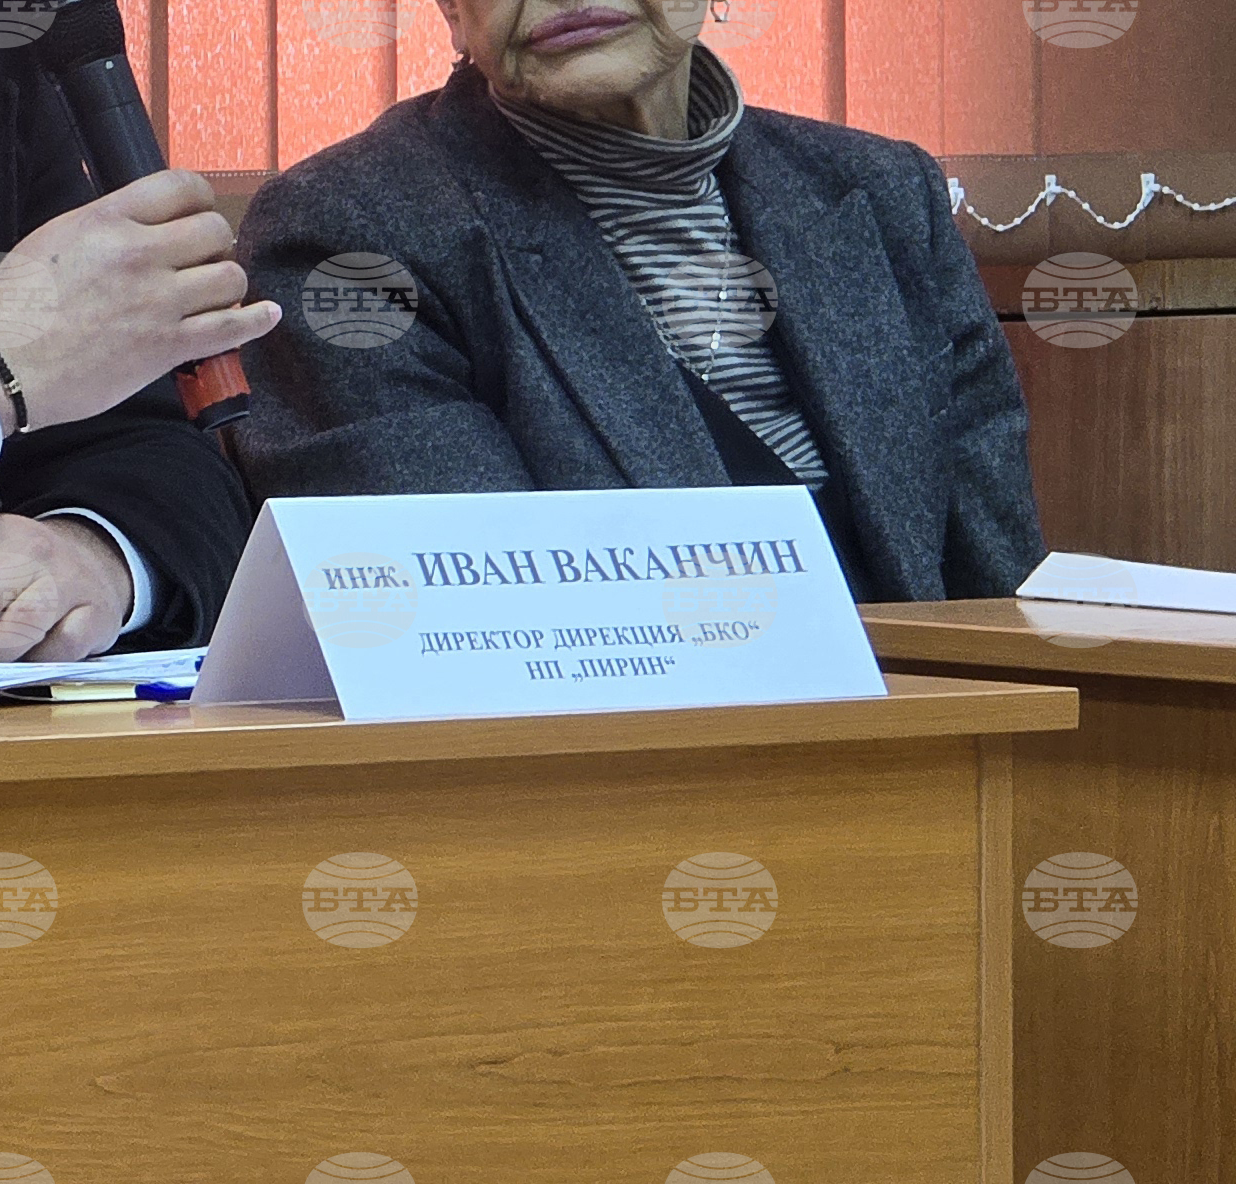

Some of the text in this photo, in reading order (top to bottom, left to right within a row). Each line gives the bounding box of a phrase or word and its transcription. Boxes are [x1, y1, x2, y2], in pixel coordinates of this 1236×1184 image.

[322, 539, 808, 590] инж. ИВАН ВАКАНЧИН
[418, 629, 544, 657] ДИРЕКТОР
[552, 624, 685, 651] ДИРЕКЦИЯ
[525, 656, 676, 682] НП „ПИРИН“
